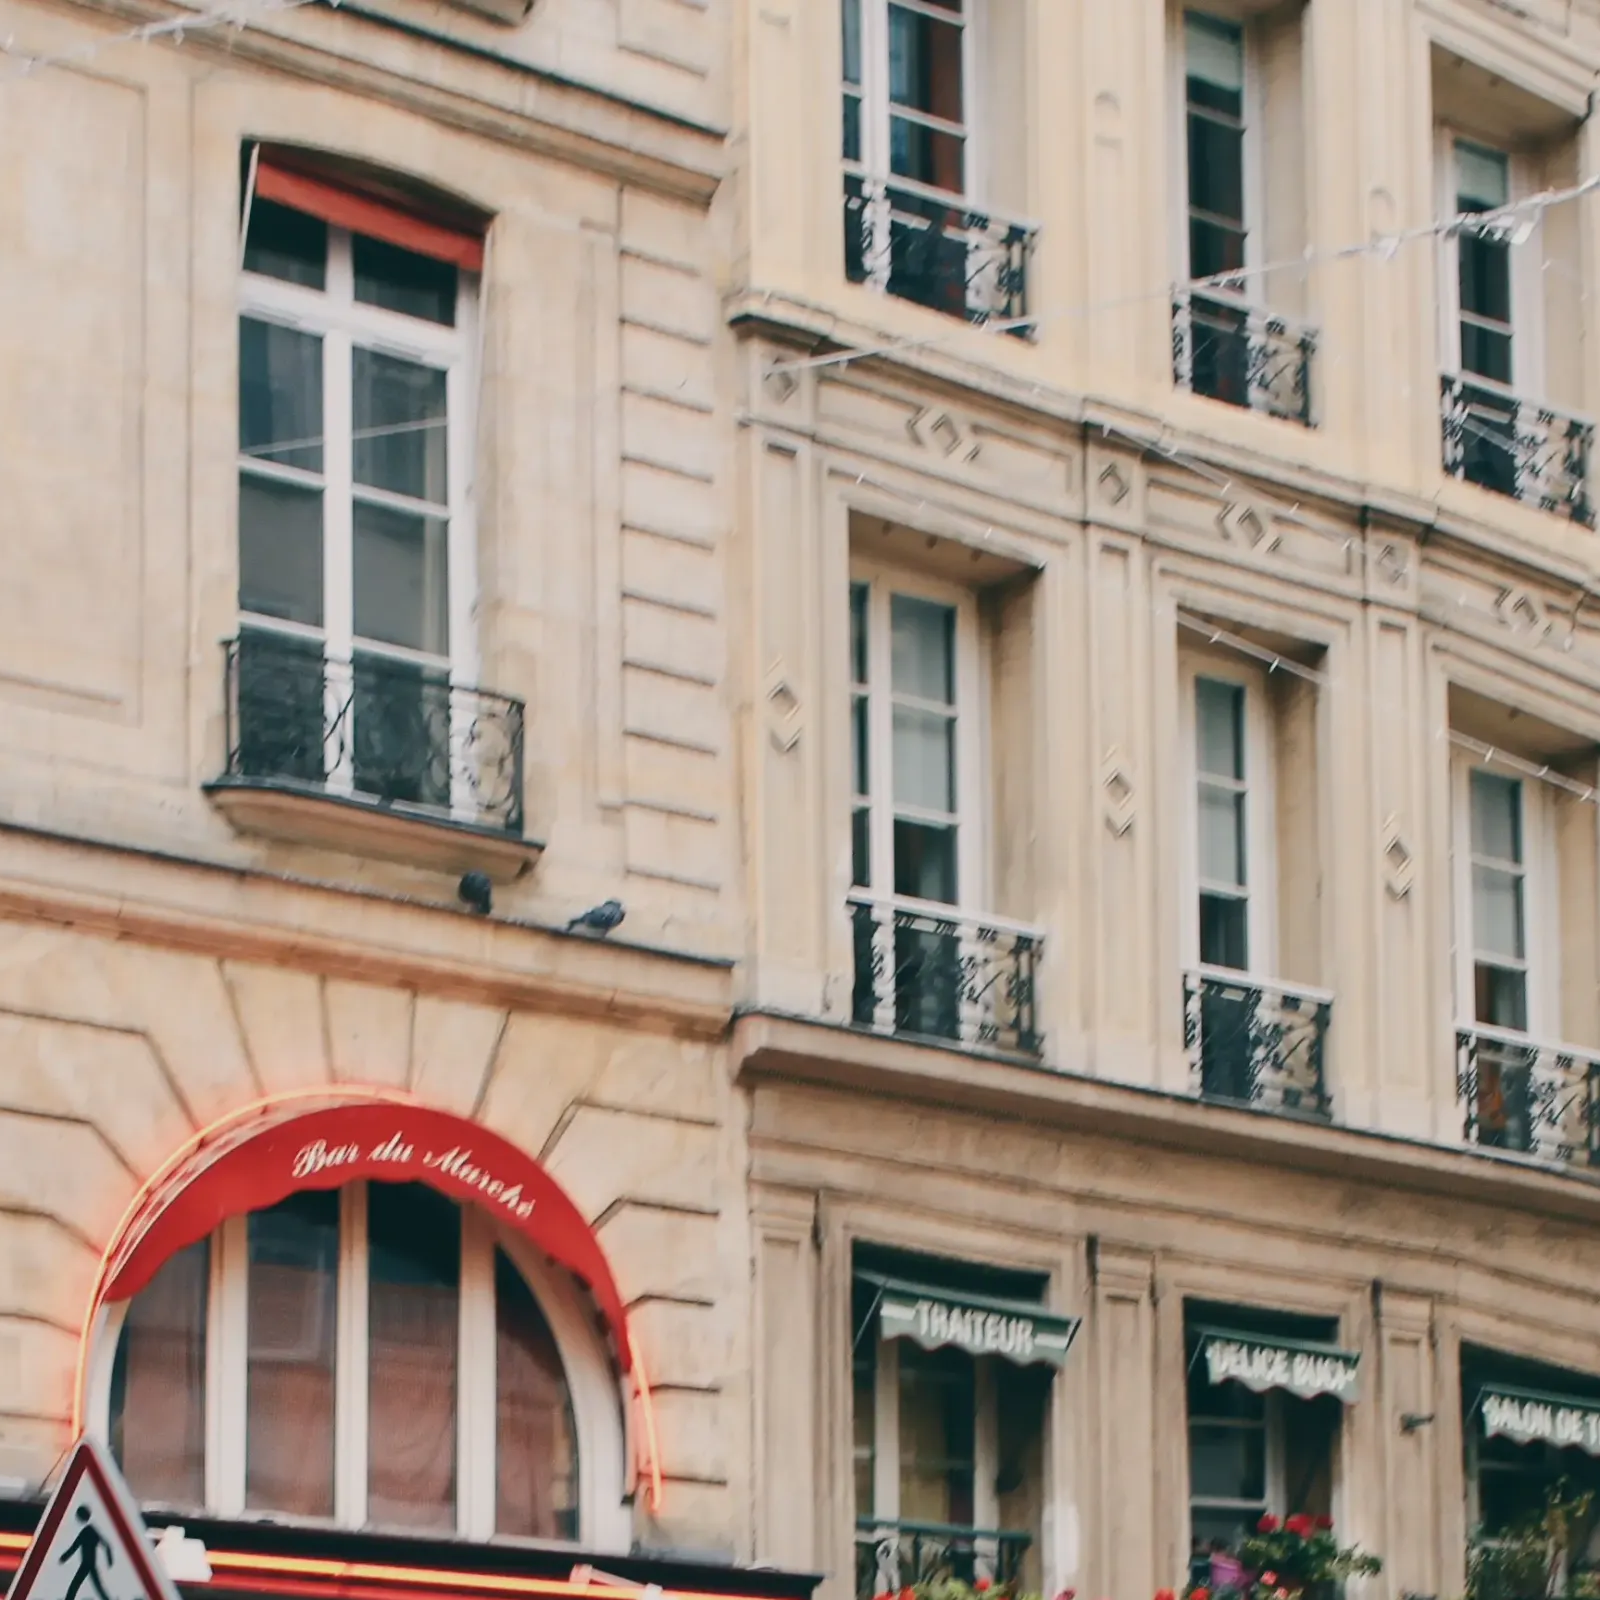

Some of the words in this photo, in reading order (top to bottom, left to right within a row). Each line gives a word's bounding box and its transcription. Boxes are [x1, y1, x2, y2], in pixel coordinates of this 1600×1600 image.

[291, 1138, 361, 1178] Bar
[366, 1131, 412, 1164] du
[423, 1145, 536, 1220] Marché
[916, 1299, 1034, 1355] TRAITEUR
[1486, 1394, 1552, 1436] SALON
[1556, 1408, 1584, 1442] DE
